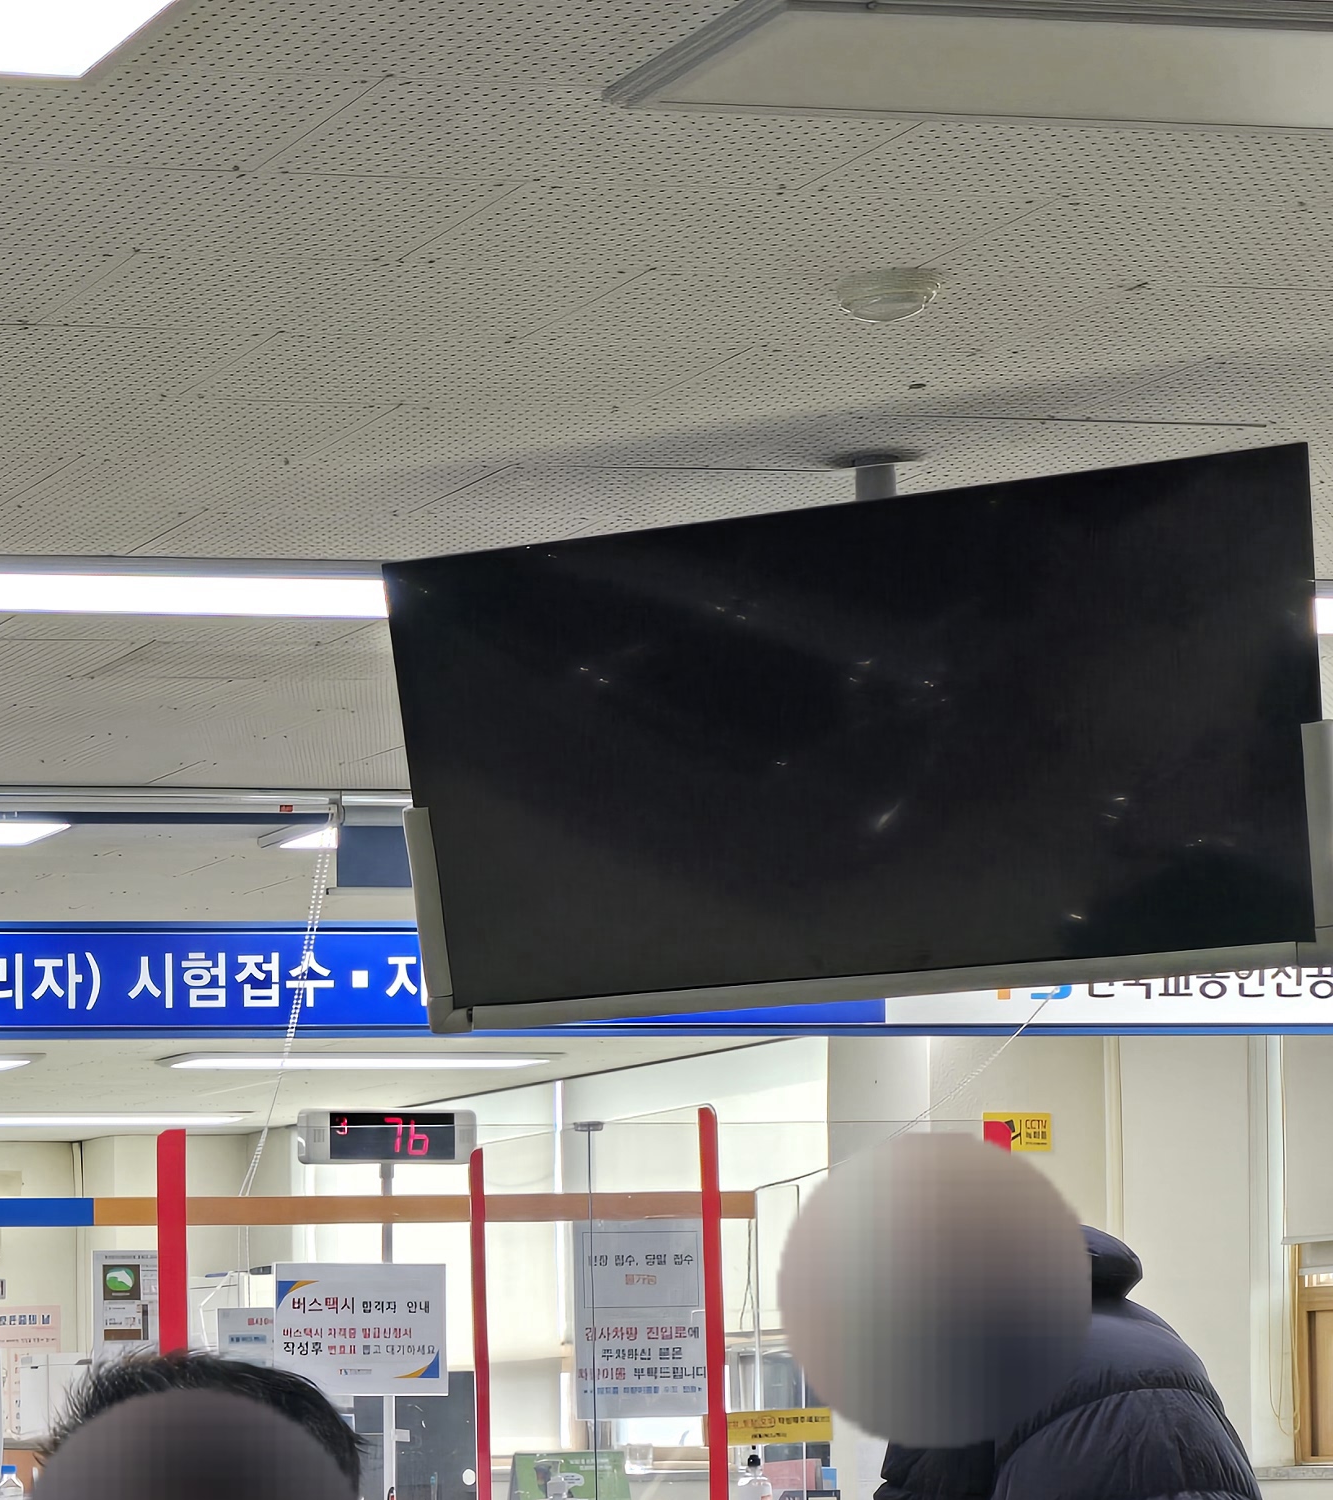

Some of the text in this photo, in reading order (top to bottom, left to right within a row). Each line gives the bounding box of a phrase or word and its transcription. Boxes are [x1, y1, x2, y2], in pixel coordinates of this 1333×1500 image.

[126, 952, 336, 1011] 시험접수
[383, 1116, 430, 1156] 76
[1025, 1119, 1047, 1130] CCTV
[406, 1300, 431, 1314] 안내
